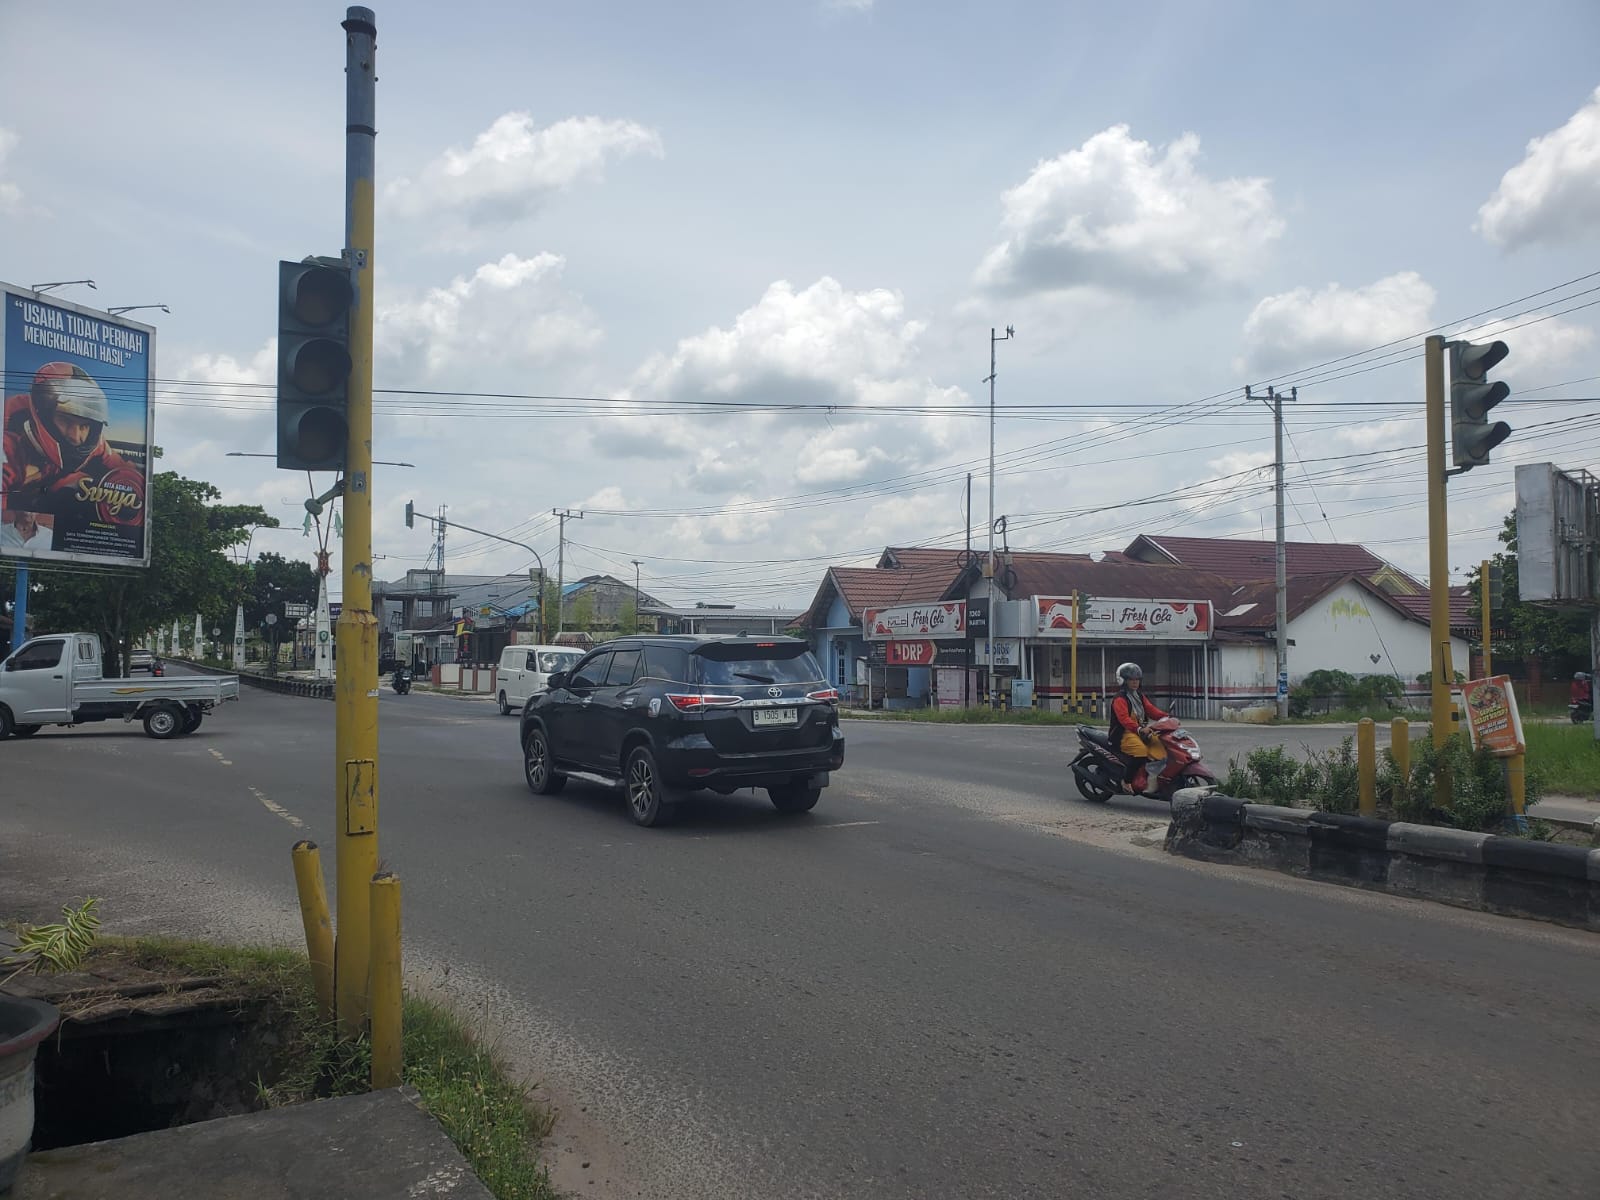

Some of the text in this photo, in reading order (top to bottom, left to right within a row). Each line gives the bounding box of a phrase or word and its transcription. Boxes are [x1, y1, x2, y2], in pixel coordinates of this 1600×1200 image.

[24, 325, 97, 360] MENGKHIANATI
[66, 314, 100, 342] TIDAK
[102, 325, 143, 354] PERNAH
[75, 477, 142, 515] Surya
[911, 609, 929, 628] Fresh
[929, 608, 945, 628] Cola
[1119, 607, 1148, 624] Fresh
[1150, 607, 1172, 625] Cola
[902, 643, 923, 661] DRP
[754, 711, 760, 720] B
